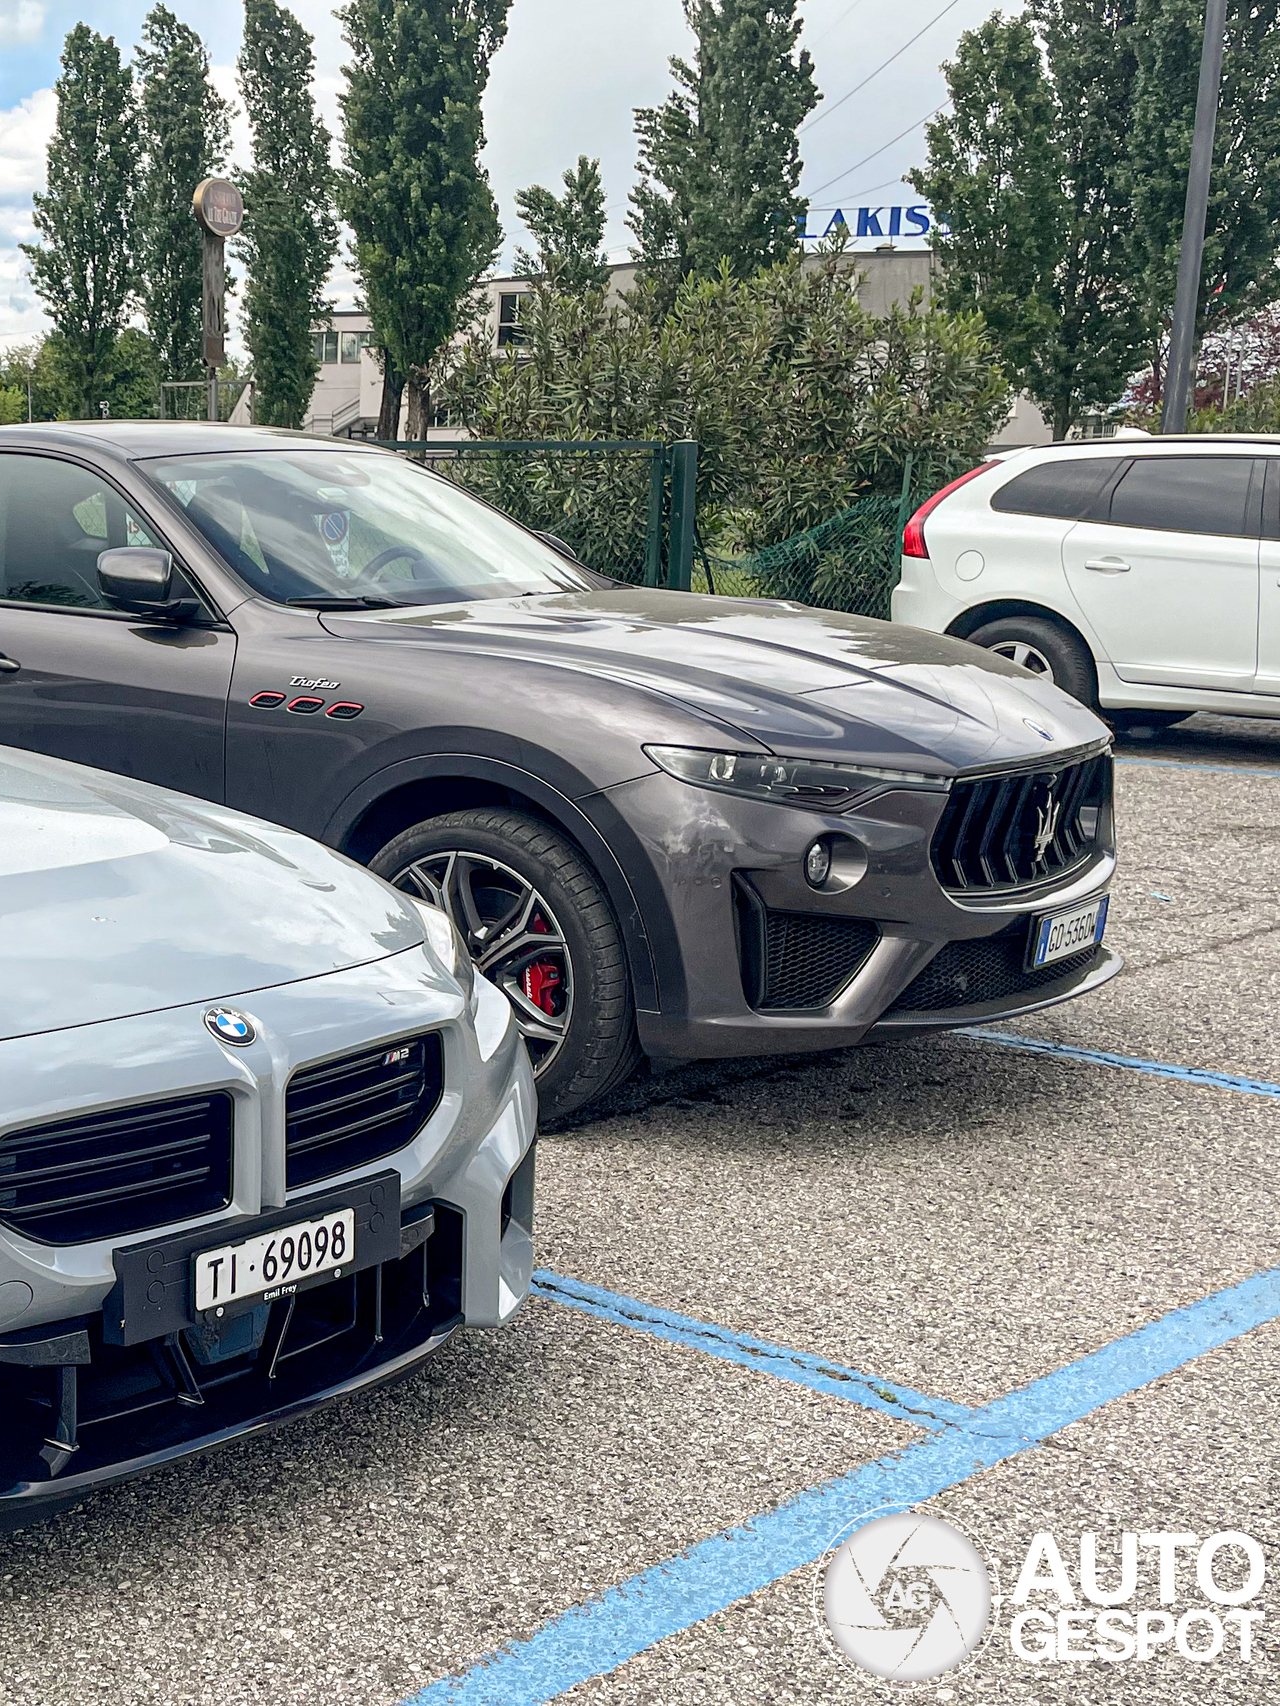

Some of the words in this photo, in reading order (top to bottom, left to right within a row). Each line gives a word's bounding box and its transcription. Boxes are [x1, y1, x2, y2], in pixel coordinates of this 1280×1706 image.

[289, 675, 340, 691] Trofeo
[1048, 923, 1065, 953] GD
[207, 1253, 238, 1301] TI
[262, 1220, 346, 1282] 69098
[263, 1287, 280, 1301] Emil
[281, 1284, 298, 1298] Frey
